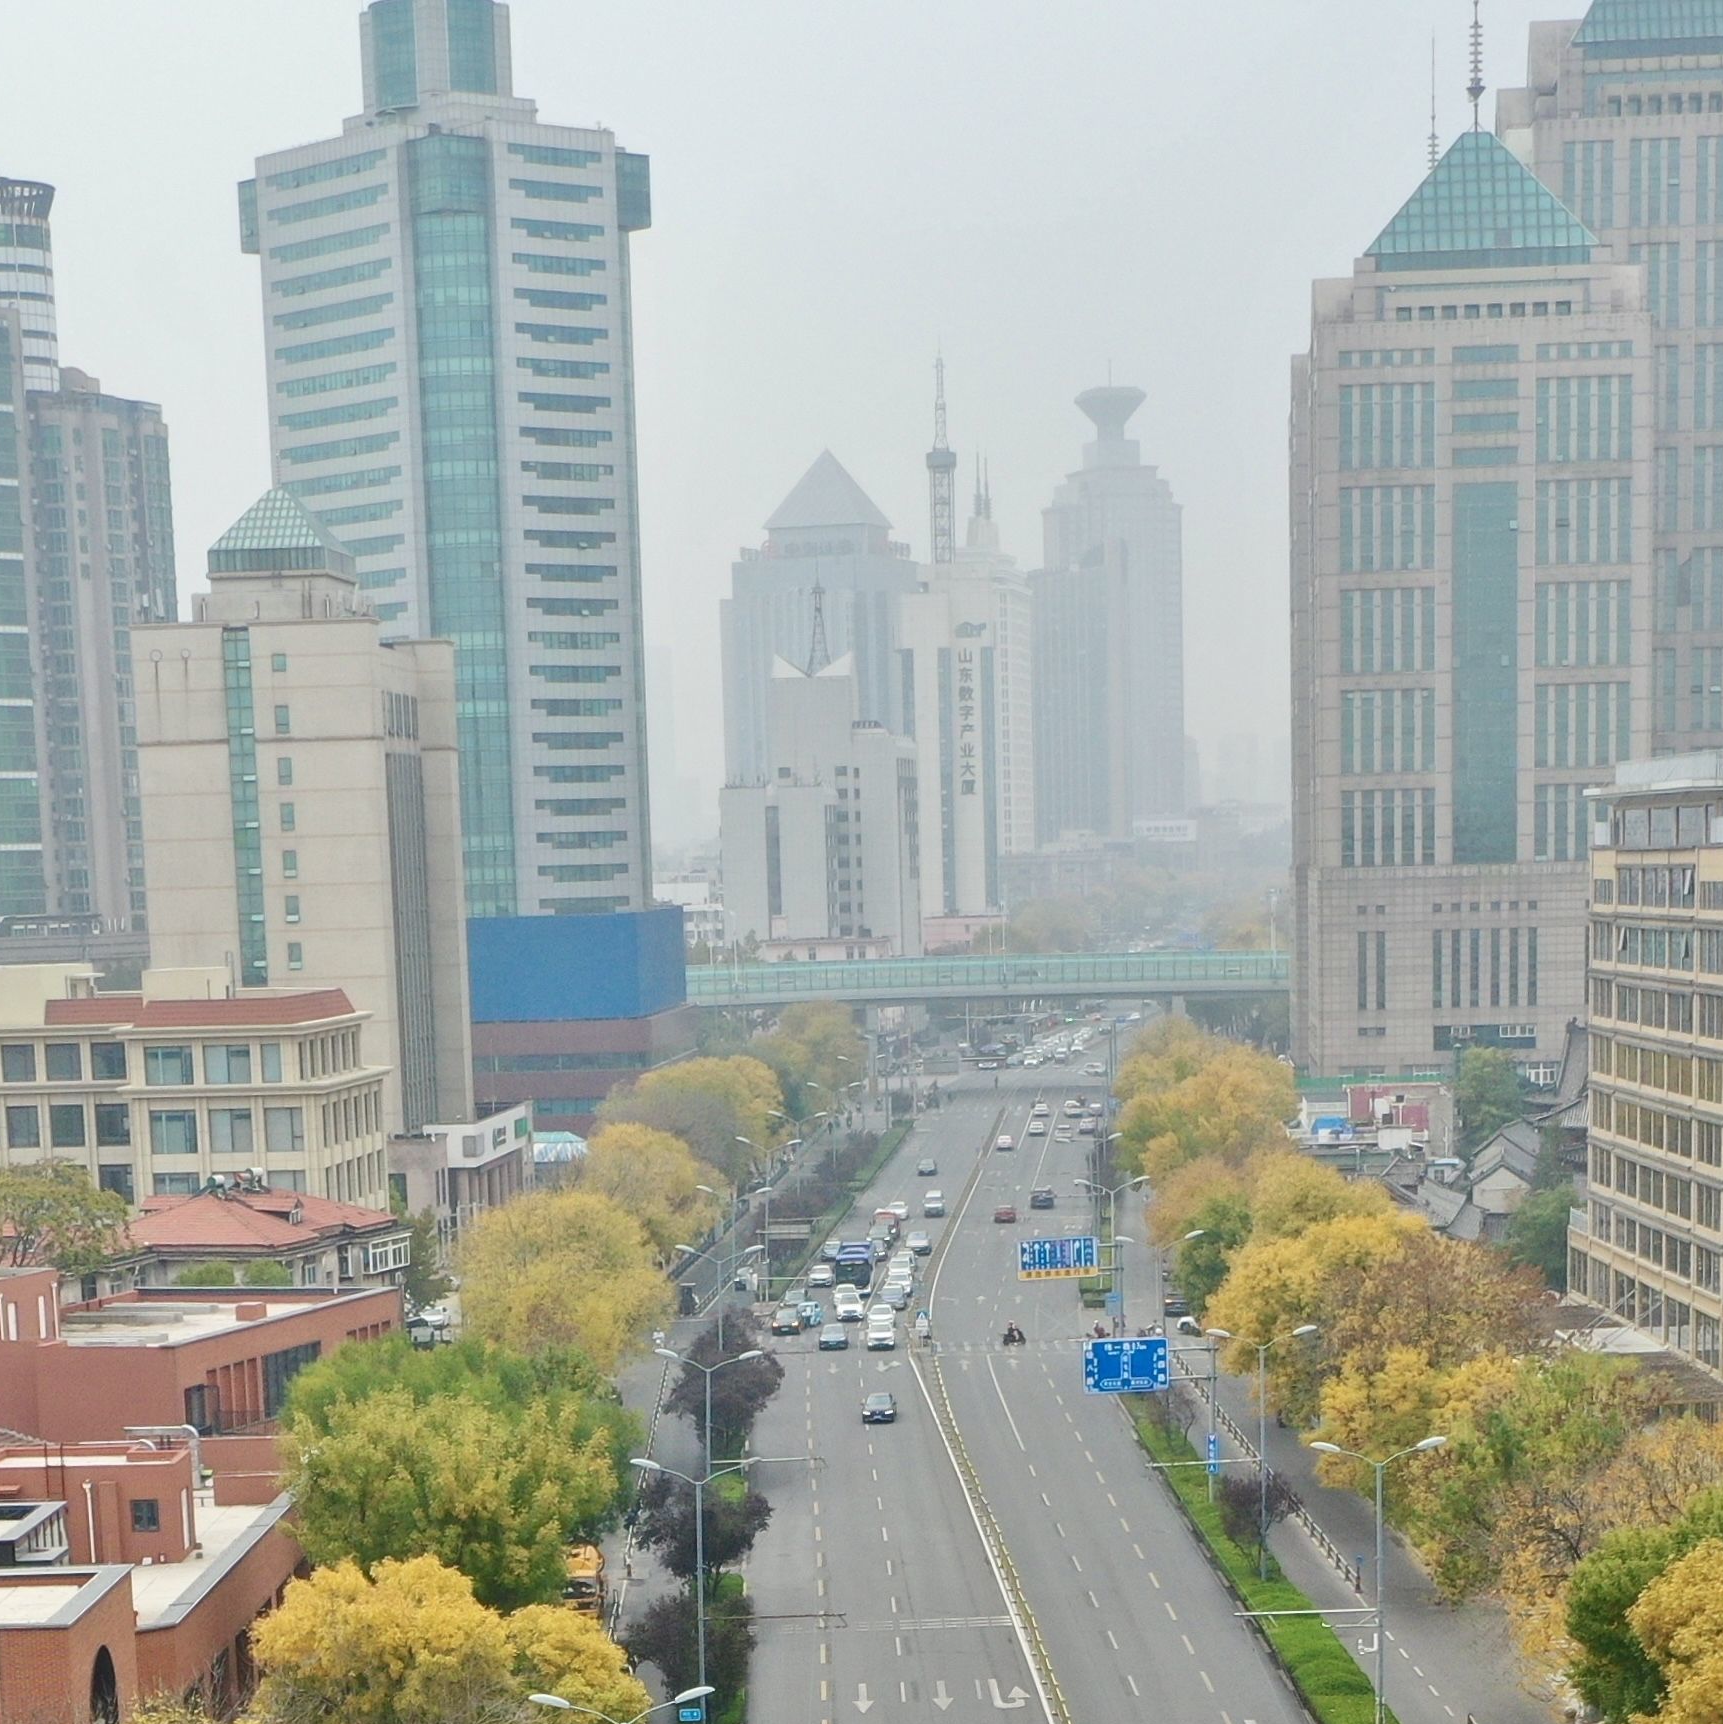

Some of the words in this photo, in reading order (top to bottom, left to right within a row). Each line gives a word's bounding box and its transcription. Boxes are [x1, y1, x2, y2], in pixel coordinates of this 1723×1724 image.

[958, 648, 976, 796] 山东数字产业大厦
